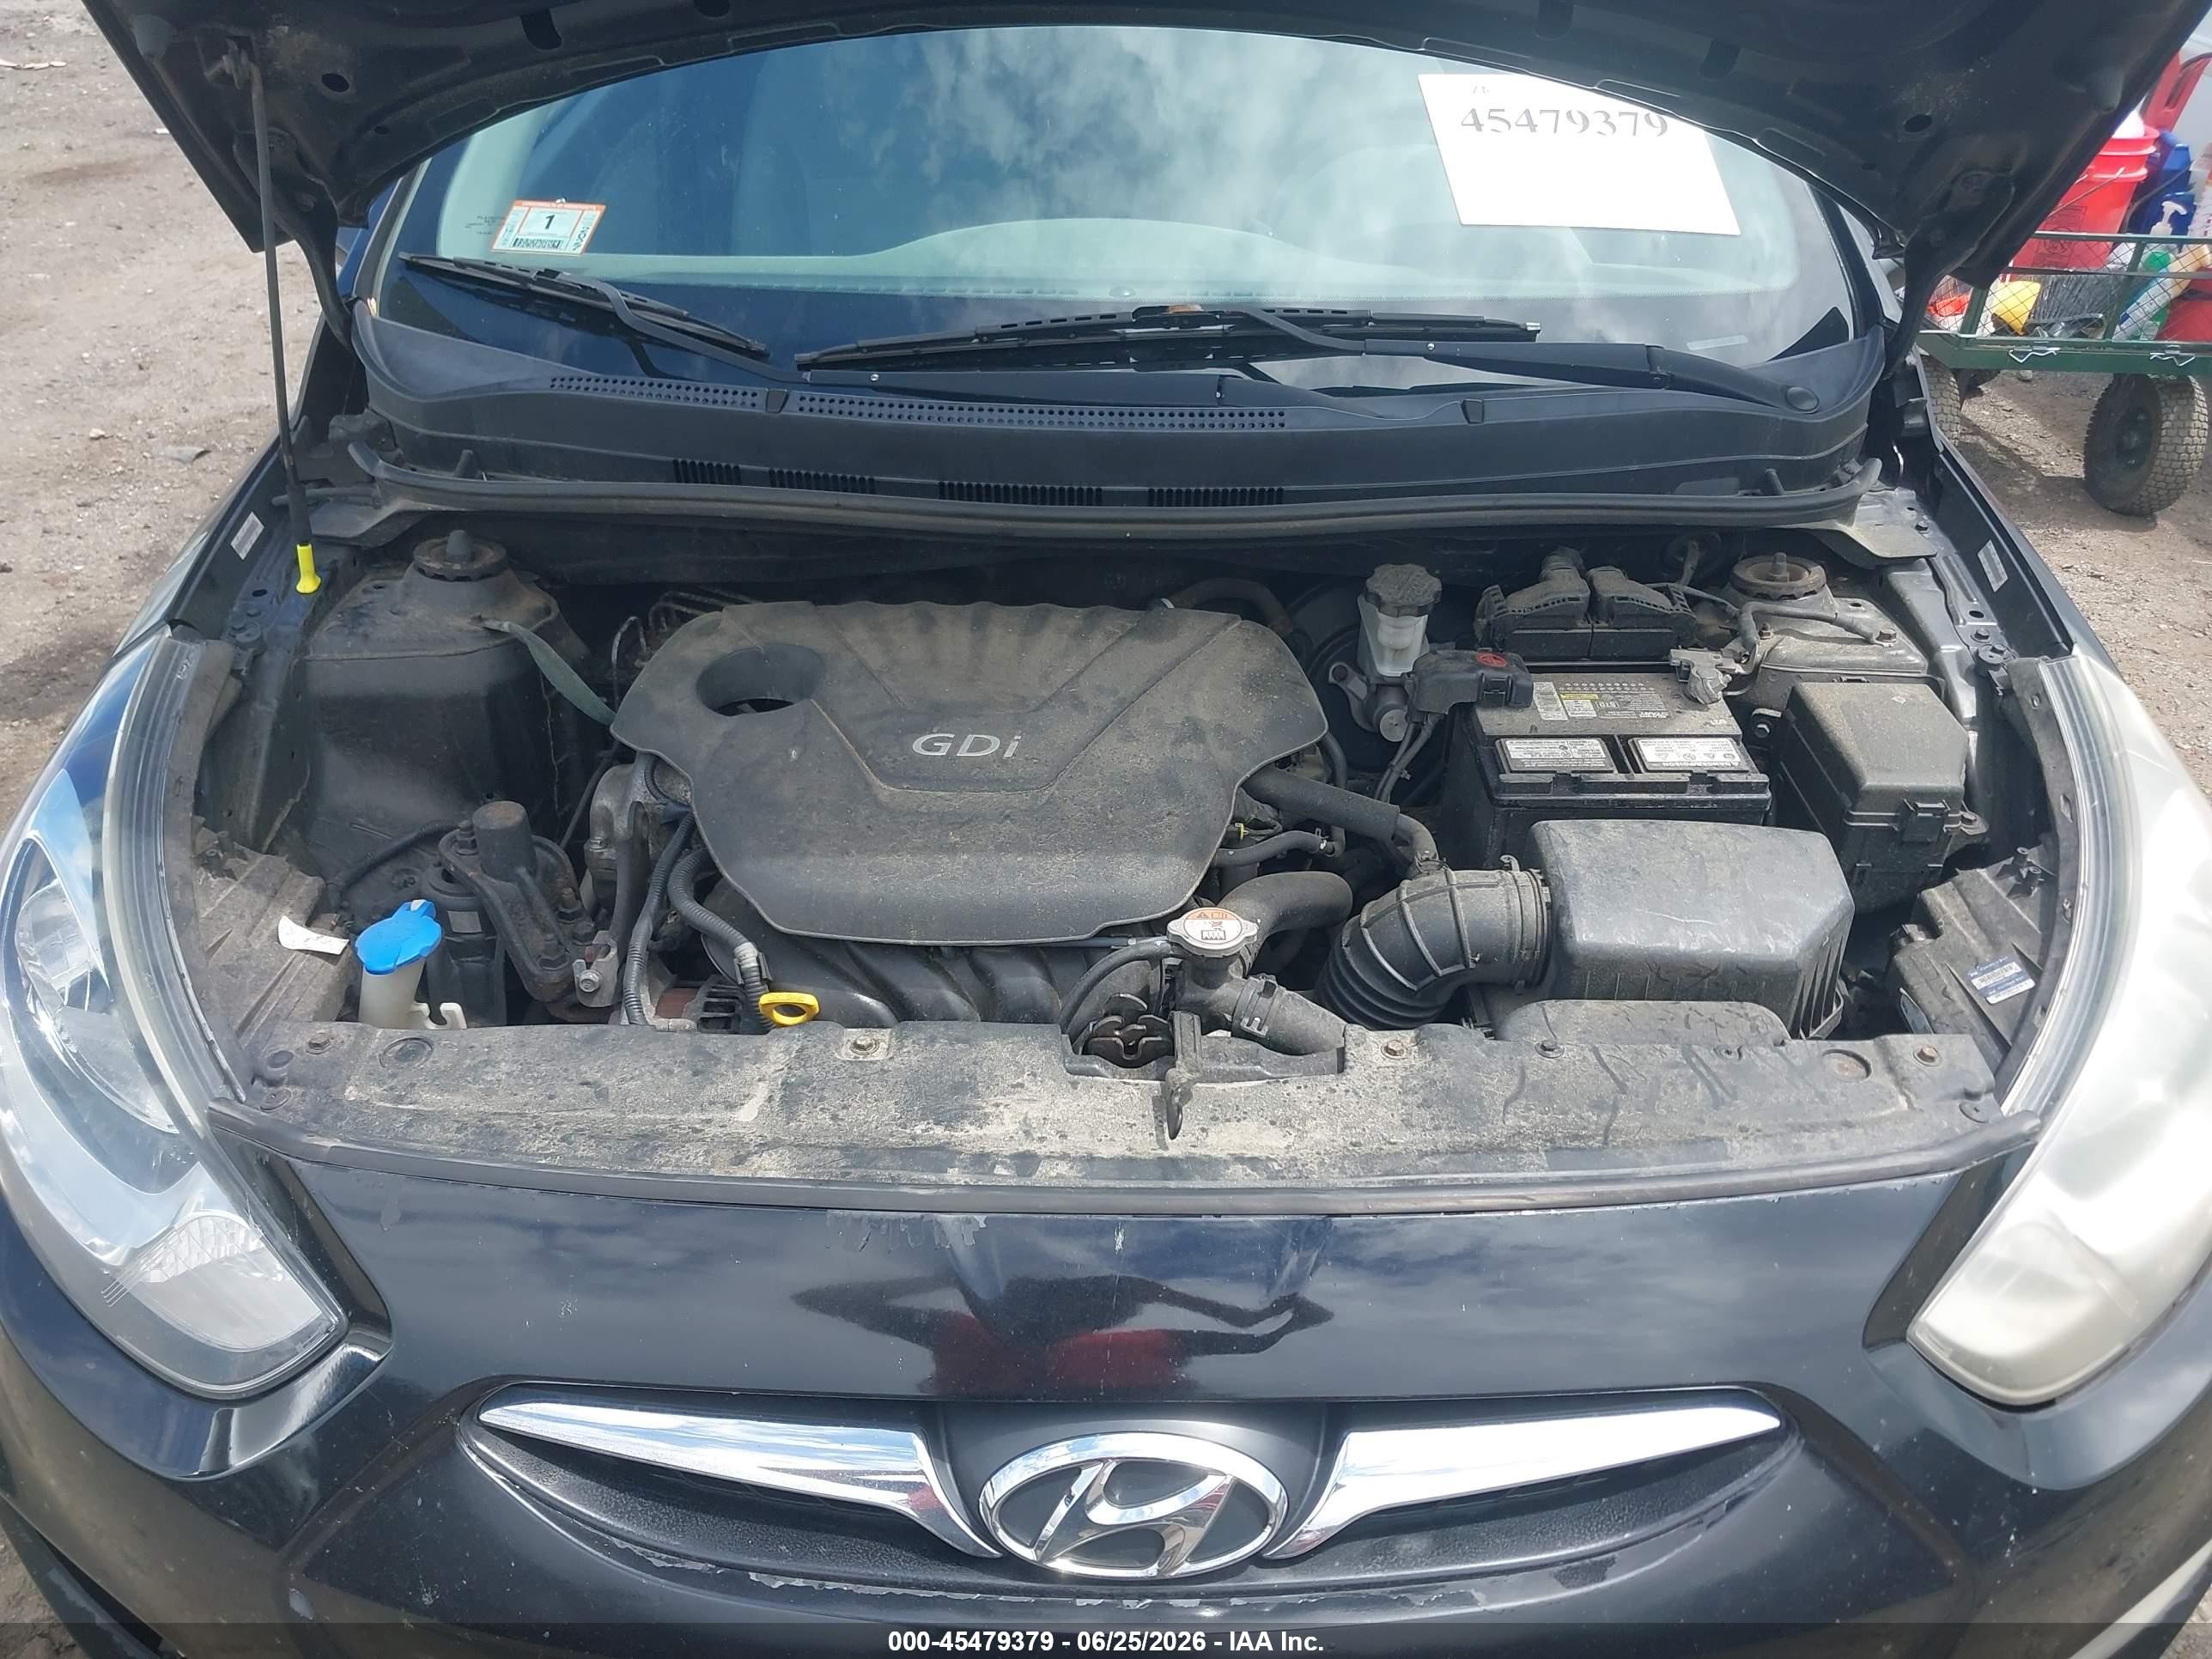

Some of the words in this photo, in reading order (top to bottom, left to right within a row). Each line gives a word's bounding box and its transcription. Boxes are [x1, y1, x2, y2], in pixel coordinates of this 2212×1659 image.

[1460, 107, 1668, 137] 45479379
[544, 214, 556, 230] 1
[912, 733, 1022, 758] GDi
